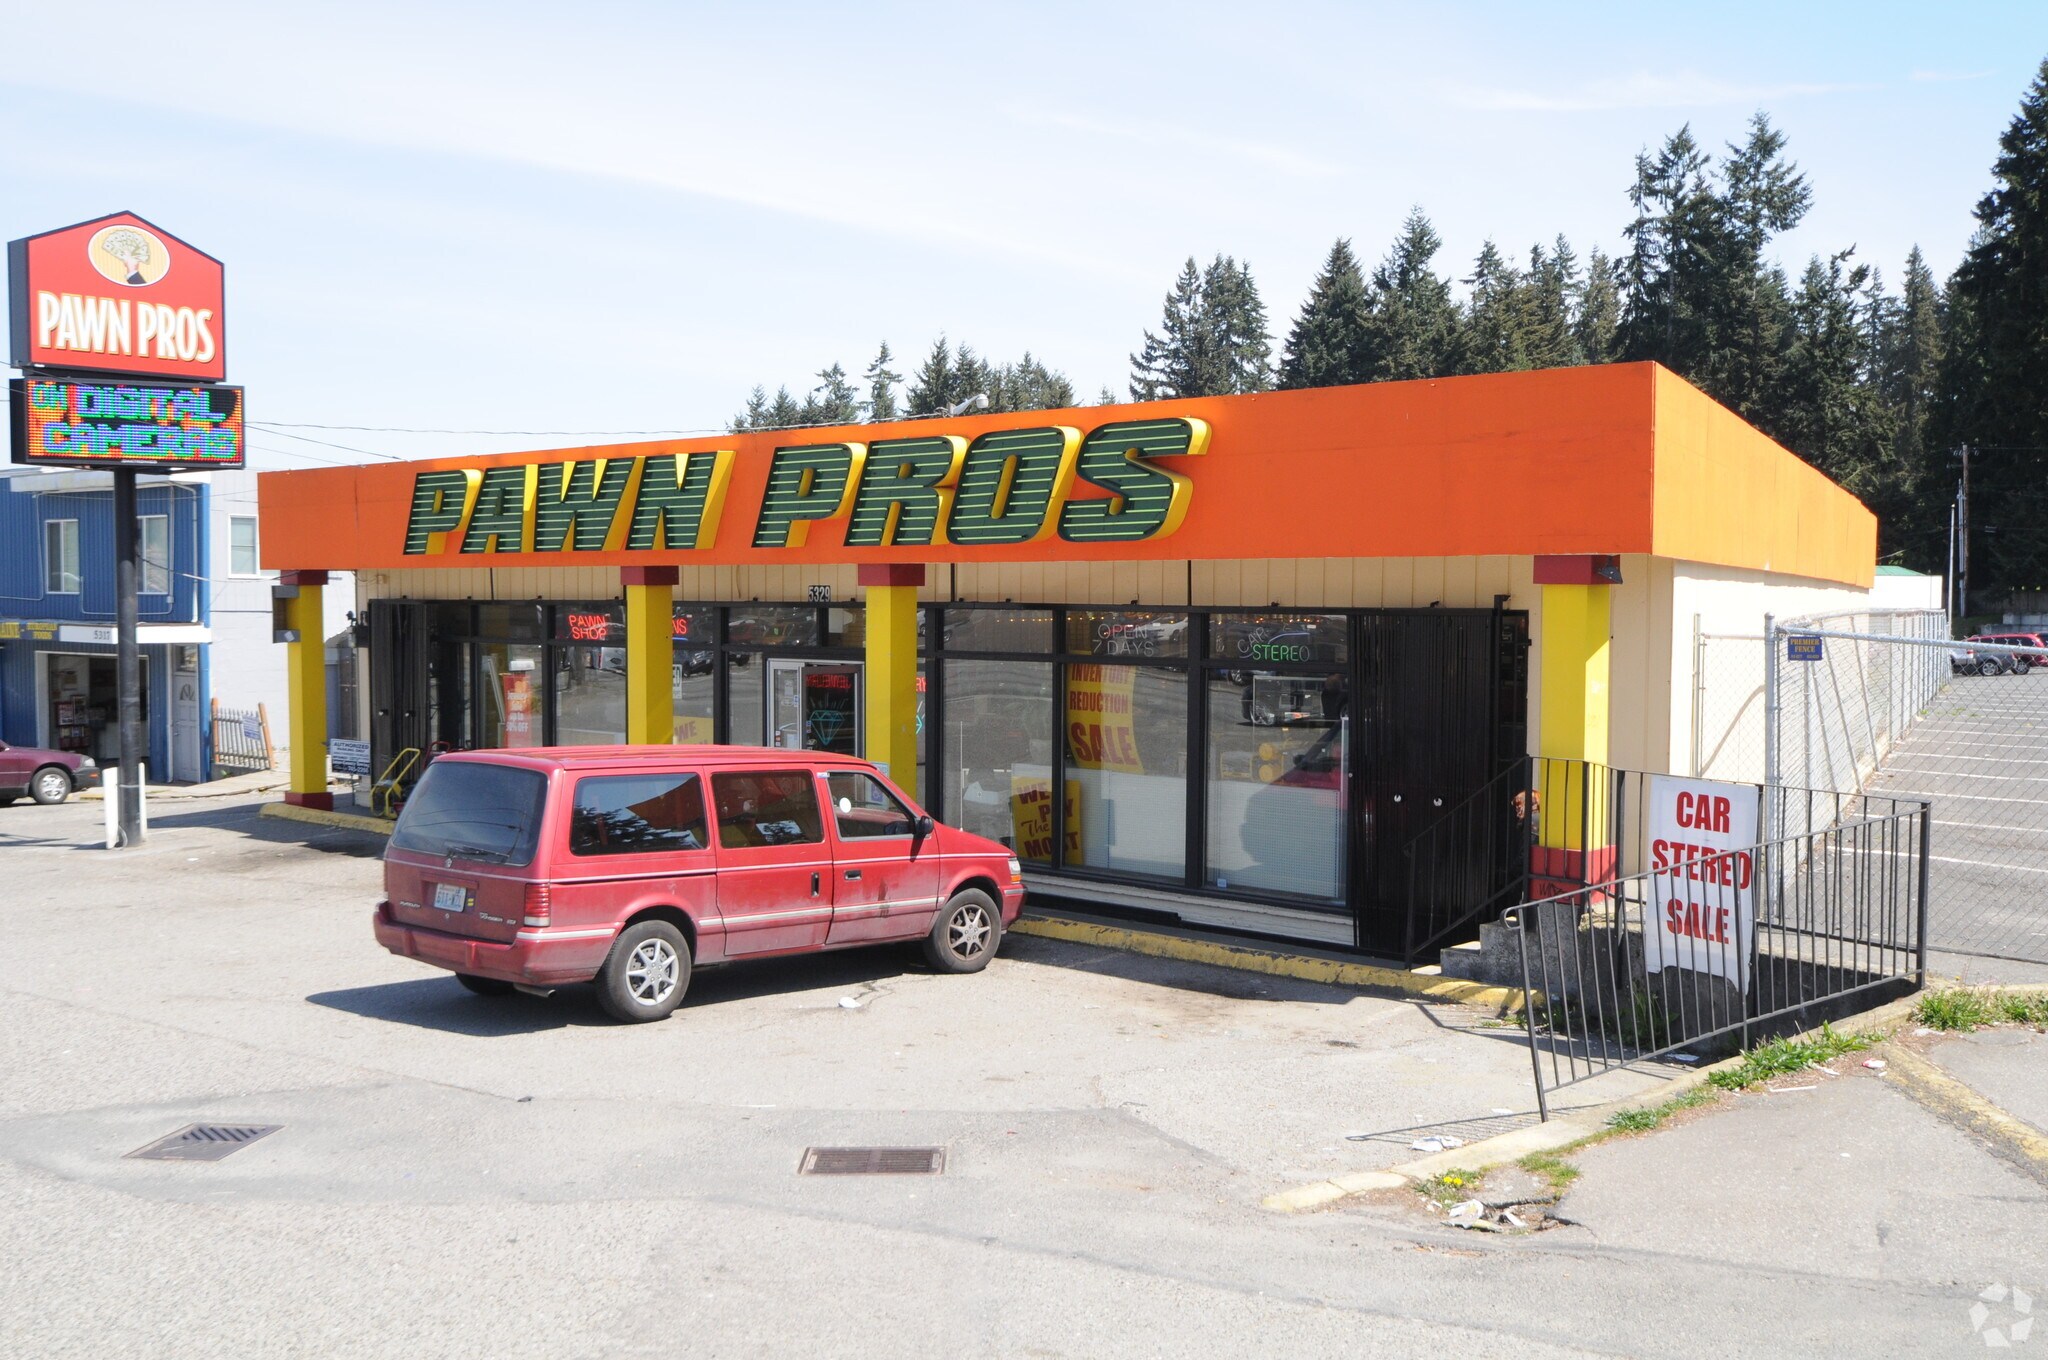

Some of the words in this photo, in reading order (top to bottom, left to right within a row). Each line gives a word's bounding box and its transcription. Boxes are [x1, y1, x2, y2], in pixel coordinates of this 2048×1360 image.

[38, 290, 132, 356] PAWN
[137, 301, 216, 363] PROS
[76, 385, 226, 422] DIGITAL
[43, 422, 236, 459] CAMERAS
[403, 450, 734, 554] PAWN
[751, 418, 1211, 549] PROS
[808, 585, 831, 602] 5329
[568, 614, 606, 627] PAWN
[1097, 623, 1148, 640] OPEN
[94, 630, 111, 640] 5317
[572, 627, 607, 640] SHOP
[1091, 639, 1101, 654] 7
[1107, 640, 1155, 657] DAYS
[1252, 644, 1310, 662] STEREO
[1071, 664, 1130, 685] INVENTORY
[1069, 690, 1129, 714] REDUCTION
[1070, 721, 1139, 766] SALE
[1017, 782, 1051, 804] WE
[1038, 799, 1074, 822] PY
[1676, 791, 1731, 834] CAR
[1021, 819, 1050, 837] The
[1024, 831, 1079, 858] MOT
[1666, 898, 1729, 945] SALE
